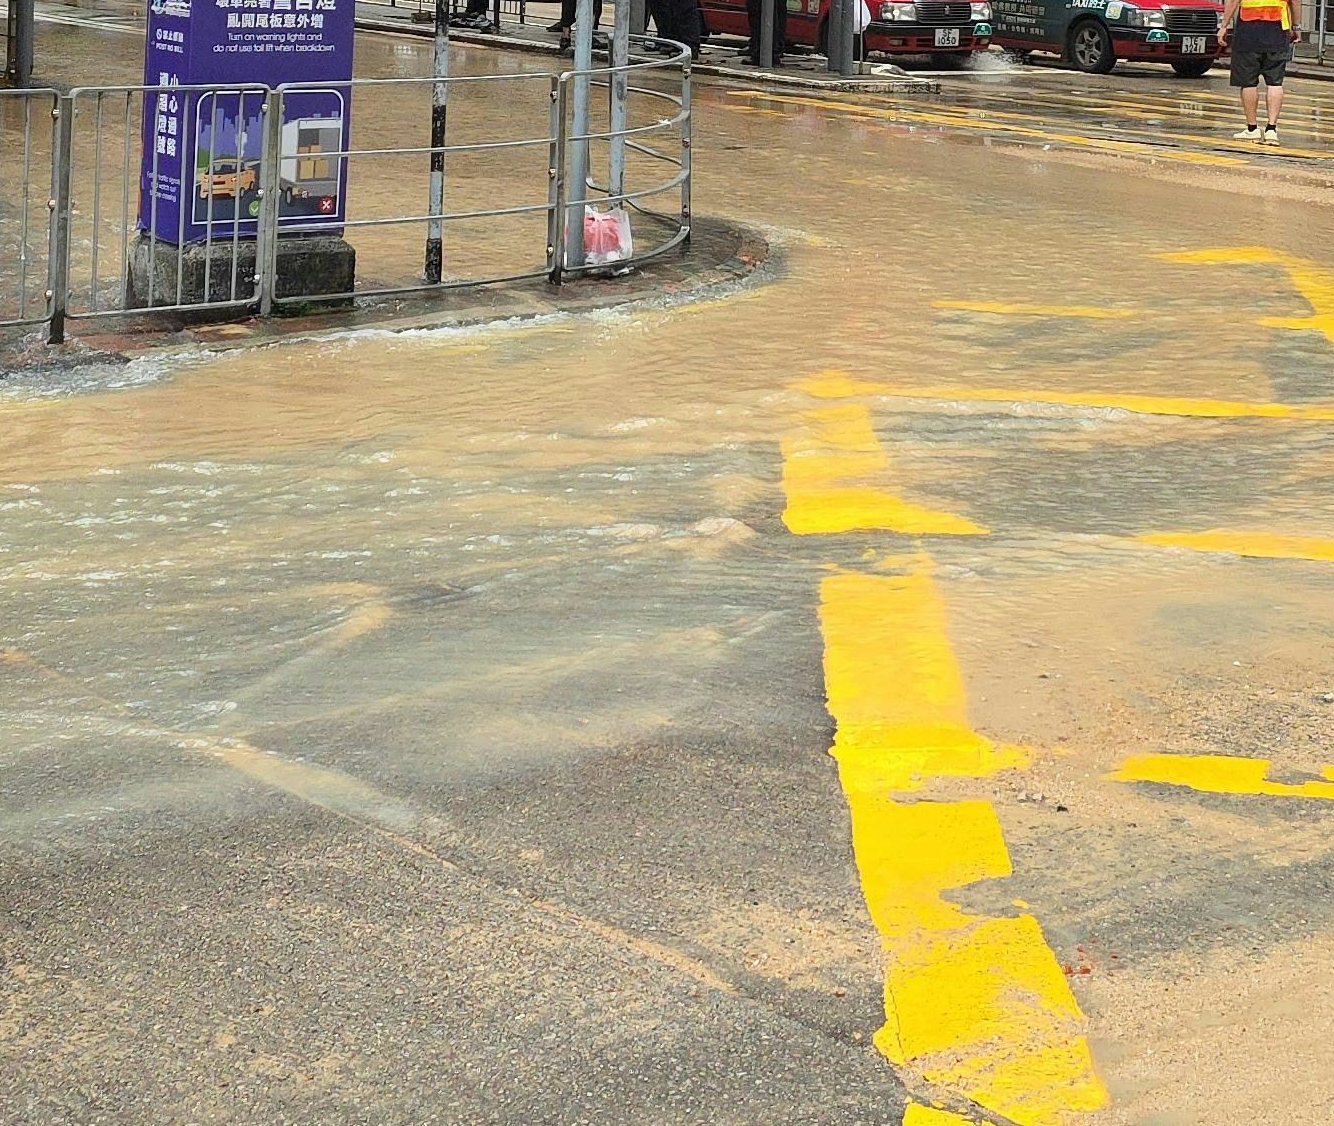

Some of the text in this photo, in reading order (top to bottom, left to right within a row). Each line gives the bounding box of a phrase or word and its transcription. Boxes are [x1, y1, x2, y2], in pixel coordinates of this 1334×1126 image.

[227, 12, 324, 28] 亂開尾板意外增
[256, 34, 285, 42] warning
[287, 33, 306, 42] lights
[307, 33, 323, 41] and
[937, 36, 957, 45] 1050
[155, 42, 167, 50] POST
[213, 44, 224, 52] do
[225, 44, 238, 52] not
[253, 44, 265, 52] tail
[265, 44, 274, 52] lift
[275, 44, 294, 52] when
[295, 44, 335, 52] breakdown
